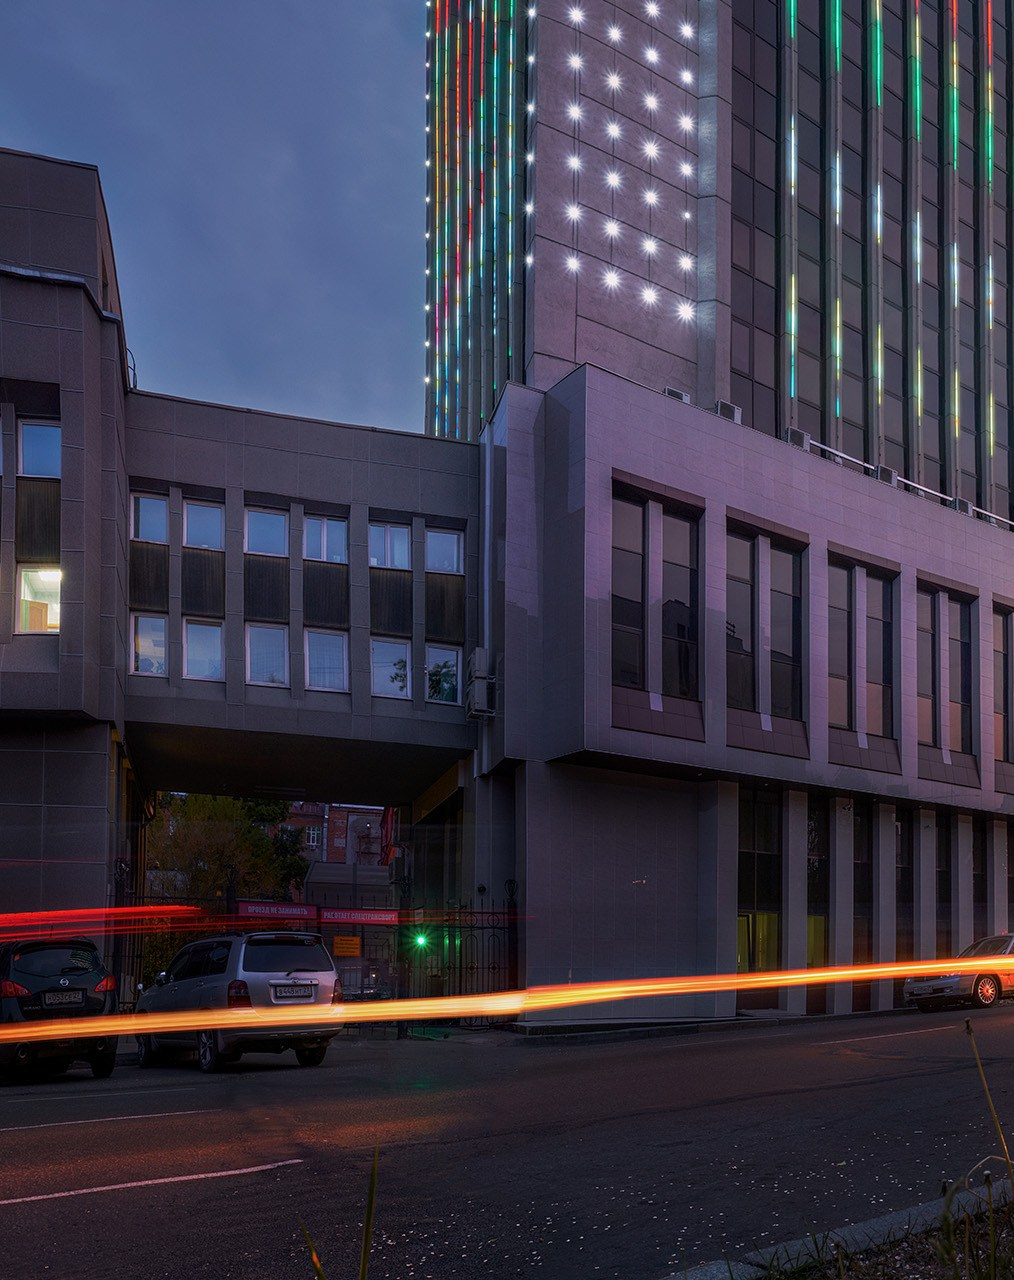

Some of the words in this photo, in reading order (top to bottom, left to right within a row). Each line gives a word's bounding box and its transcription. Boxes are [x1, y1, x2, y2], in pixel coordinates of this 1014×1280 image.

[247, 905, 270, 914] ПРОЕЗД
[270, 906, 278, 914] НЕ
[278, 906, 308, 915] ЗАНИМАТЬ
[323, 911, 350, 920] РАБОТАЕТ
